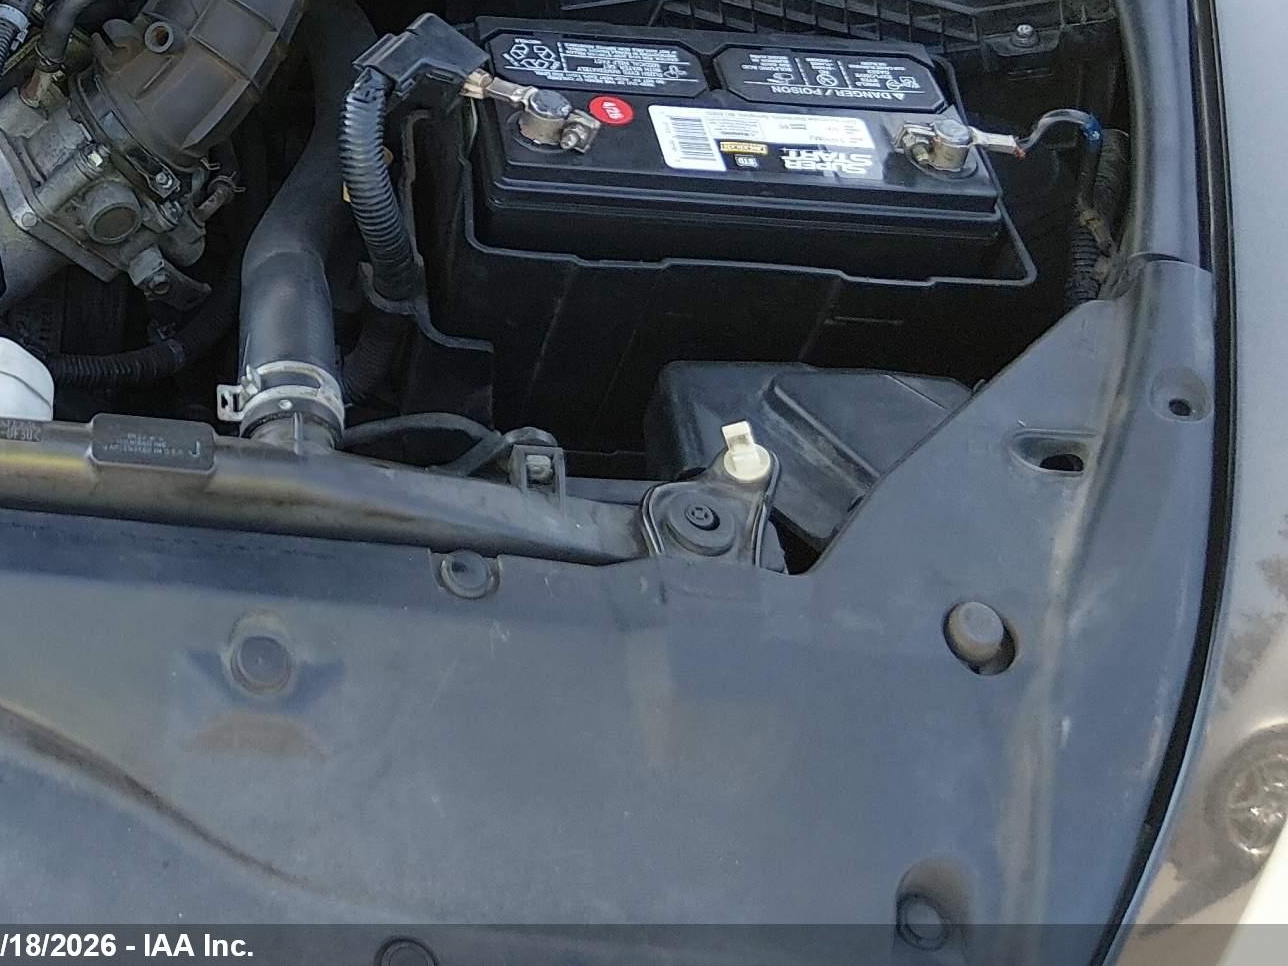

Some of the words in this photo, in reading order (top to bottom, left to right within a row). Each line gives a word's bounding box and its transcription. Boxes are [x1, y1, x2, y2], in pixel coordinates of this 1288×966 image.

[771, 85, 823, 96] POISON
[835, 89, 892, 100] DANGER
[777, 148, 874, 166] START
[783, 159, 866, 173] SUPER
